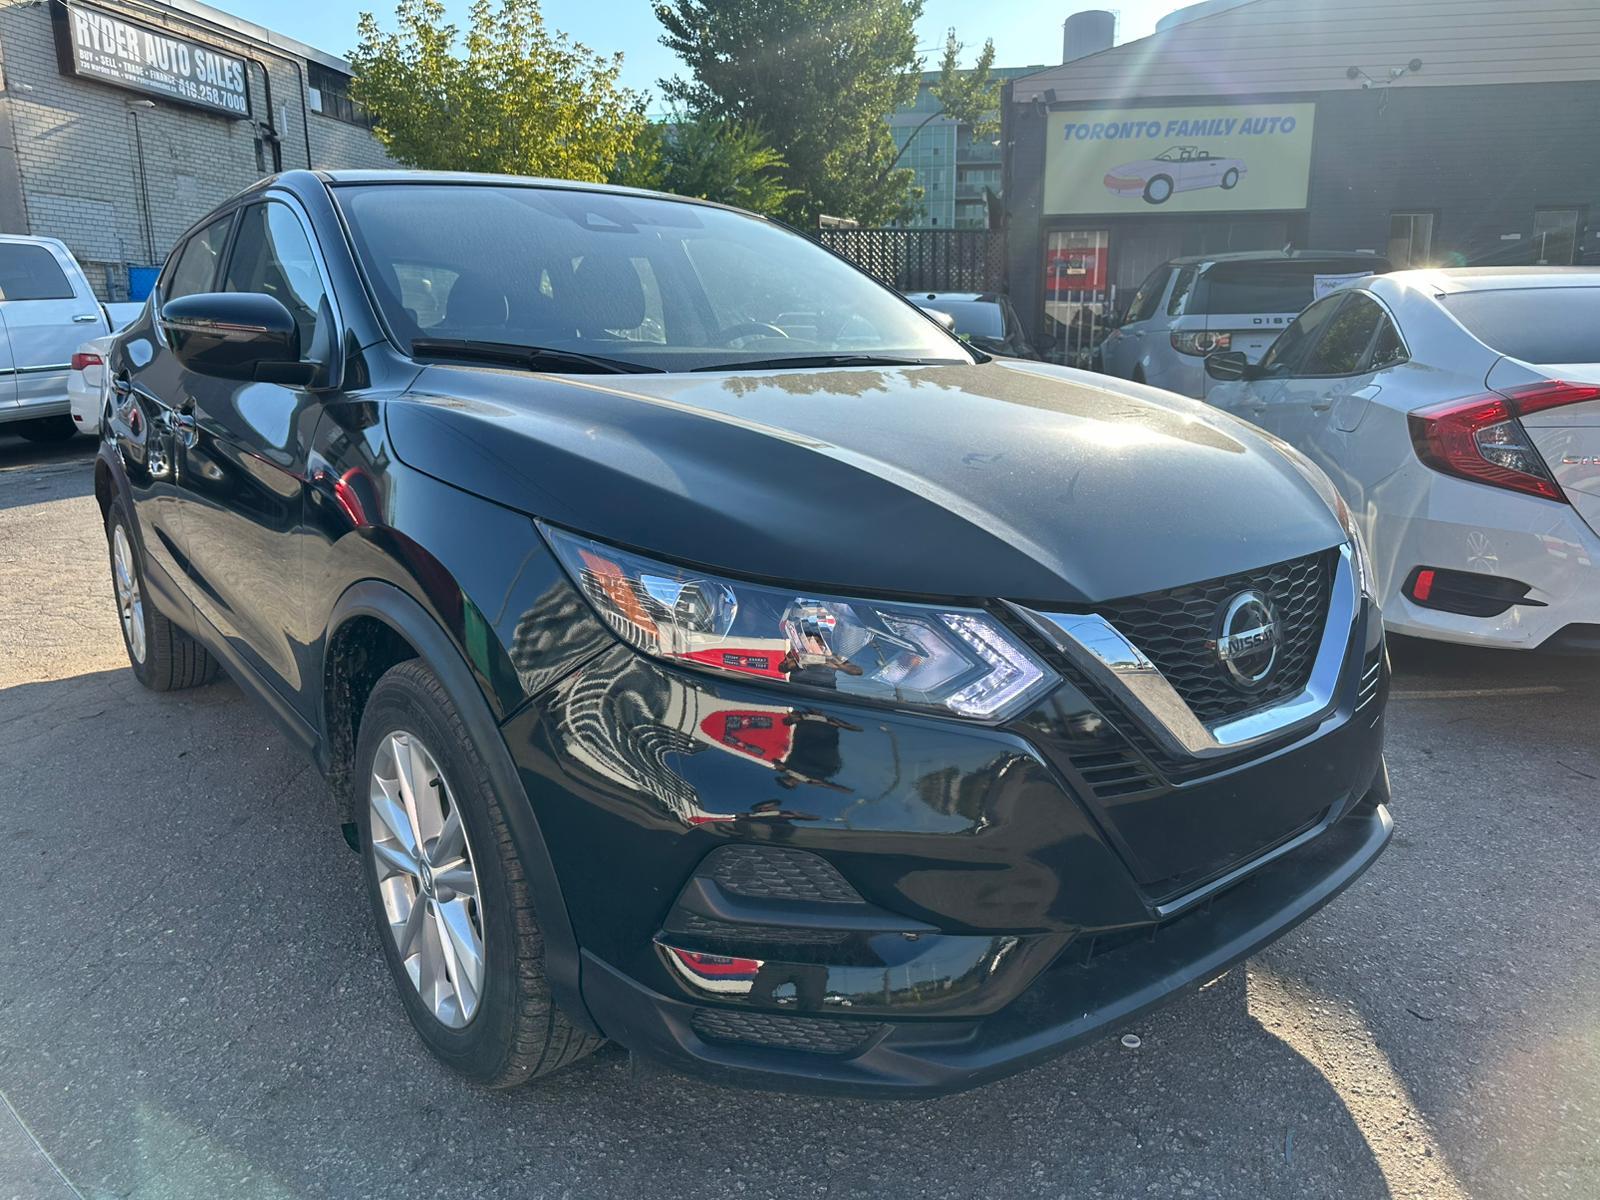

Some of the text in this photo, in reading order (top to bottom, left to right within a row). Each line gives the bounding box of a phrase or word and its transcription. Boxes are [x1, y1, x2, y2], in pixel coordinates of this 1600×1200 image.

[75, 7, 141, 63] RYDER
[144, 32, 191, 77] AUTO
[194, 49, 243, 93] SALES
[79, 48, 94, 62] BUY
[100, 55, 117, 69] SELL
[122, 61, 144, 77] TRADE
[150, 69, 176, 86] FINANCE
[178, 78, 246, 112] 416.258.7000
[1063, 116, 1297, 141] TORONTO FAMILY AUTO
[1228, 629, 1273, 655] NISSAN
